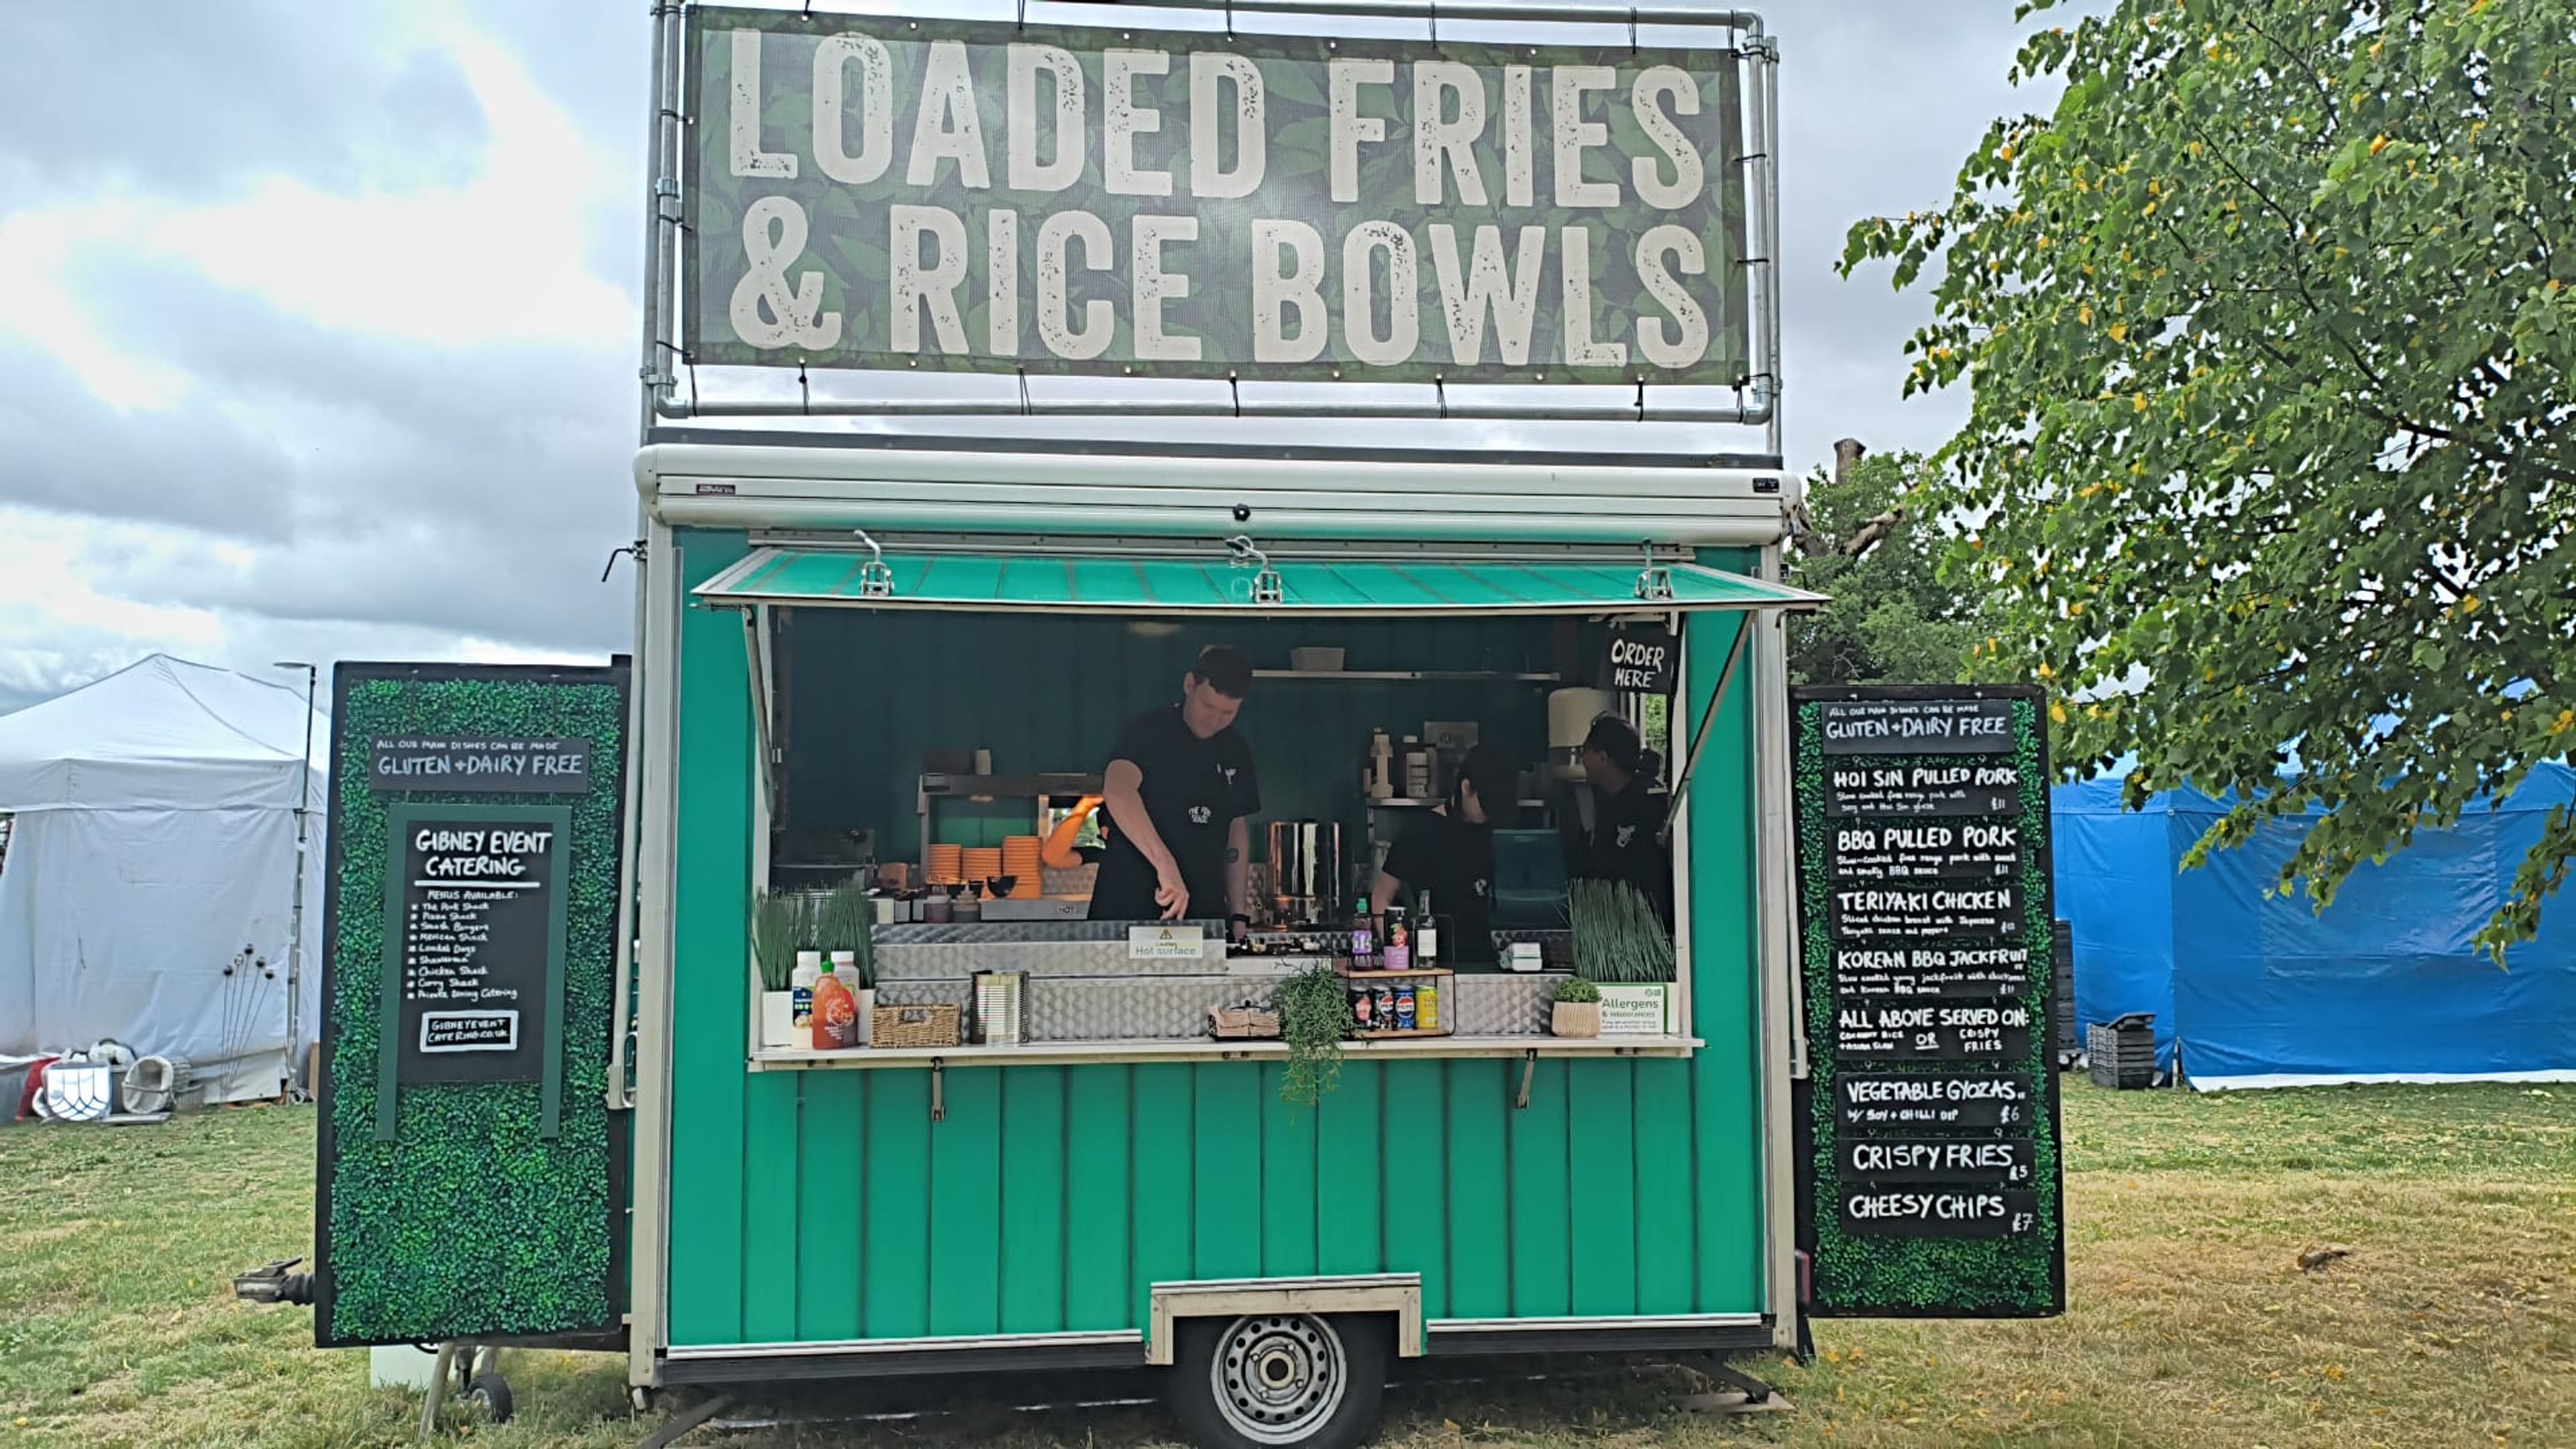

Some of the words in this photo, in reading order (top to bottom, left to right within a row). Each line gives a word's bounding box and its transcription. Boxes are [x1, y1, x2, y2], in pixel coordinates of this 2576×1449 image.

[729, 28, 1267, 199] LOADED
[1328, 58, 1703, 210] FRIES
[728, 195, 842, 352] &
[889, 205, 1202, 363] RICE
[1252, 218, 1711, 370] BOWLS
[1611, 639, 1664, 673] ORDER
[1615, 668, 1656, 688] HERE
[1829, 708, 1846, 717] ALL
[1849, 707, 1865, 715] OUR
[1923, 706, 1939, 714] CAN
[1826, 718, 1889, 739] GLUTEN
[1959, 716, 2006, 737] FREE
[377, 740, 394, 749] ALL
[398, 740, 417, 749] OUR
[422, 741, 447, 749] MAIN
[490, 742, 508, 750] CAN
[378, 755, 450, 775] GLUTEN
[533, 755, 582, 774] FREE
[1833, 769, 1866, 788] HOI
[1913, 767, 1971, 787] PULLED
[1975, 767, 2018, 786] PORK
[416, 829, 486, 851] GIBNEY
[490, 830, 552, 853] EVENT
[1837, 830, 1875, 851] BBQ
[1884, 827, 1951, 850] PULLED
[1963, 826, 2017, 847] PORK
[425, 856, 525, 876] CATERING
[1888, 865, 1910, 876] BBQ
[428, 890, 460, 900] MENUS
[1837, 891, 1928, 911] TERIYAKI
[1932, 888, 2011, 910] CHICKEN
[1136, 947, 1153, 955] Hot
[1837, 950, 1907, 970] KOREAN
[1911, 950, 1945, 968] BBQ
[1949, 948, 2028, 967] JACKFRUIT
[1602, 998, 1658, 1011] Allergens
[1839, 1009, 1874, 1028] ALL
[1878, 1008, 1935, 1028] ABOVE
[1939, 1008, 1999, 1026] SERVED
[2001, 1008, 2030, 1026] ON:
[1916, 1032, 1937, 1045] OR
[1959, 1028, 1999, 1039] CRISPY
[1964, 1040, 2002, 1053] FRIES
[1847, 1081, 1944, 1102] VEGETABLE
[1947, 1079, 2016, 1100] GYOZAS
[1866, 1108, 1888, 1121] SOY
[1899, 1108, 1935, 1120] CHILLI
[1940, 1109, 1959, 1120] DIP
[2000, 1105, 2021, 1124] £6
[1853, 1144, 1941, 1170] CRISPY
[1947, 1144, 2014, 1168] FRIES
[2009, 1165, 2029, 1181] £5
[1849, 1193, 1934, 1219] CHEESY
[1936, 1194, 2005, 1219] CHIPS
[2012, 1213, 2033, 1232] £7
